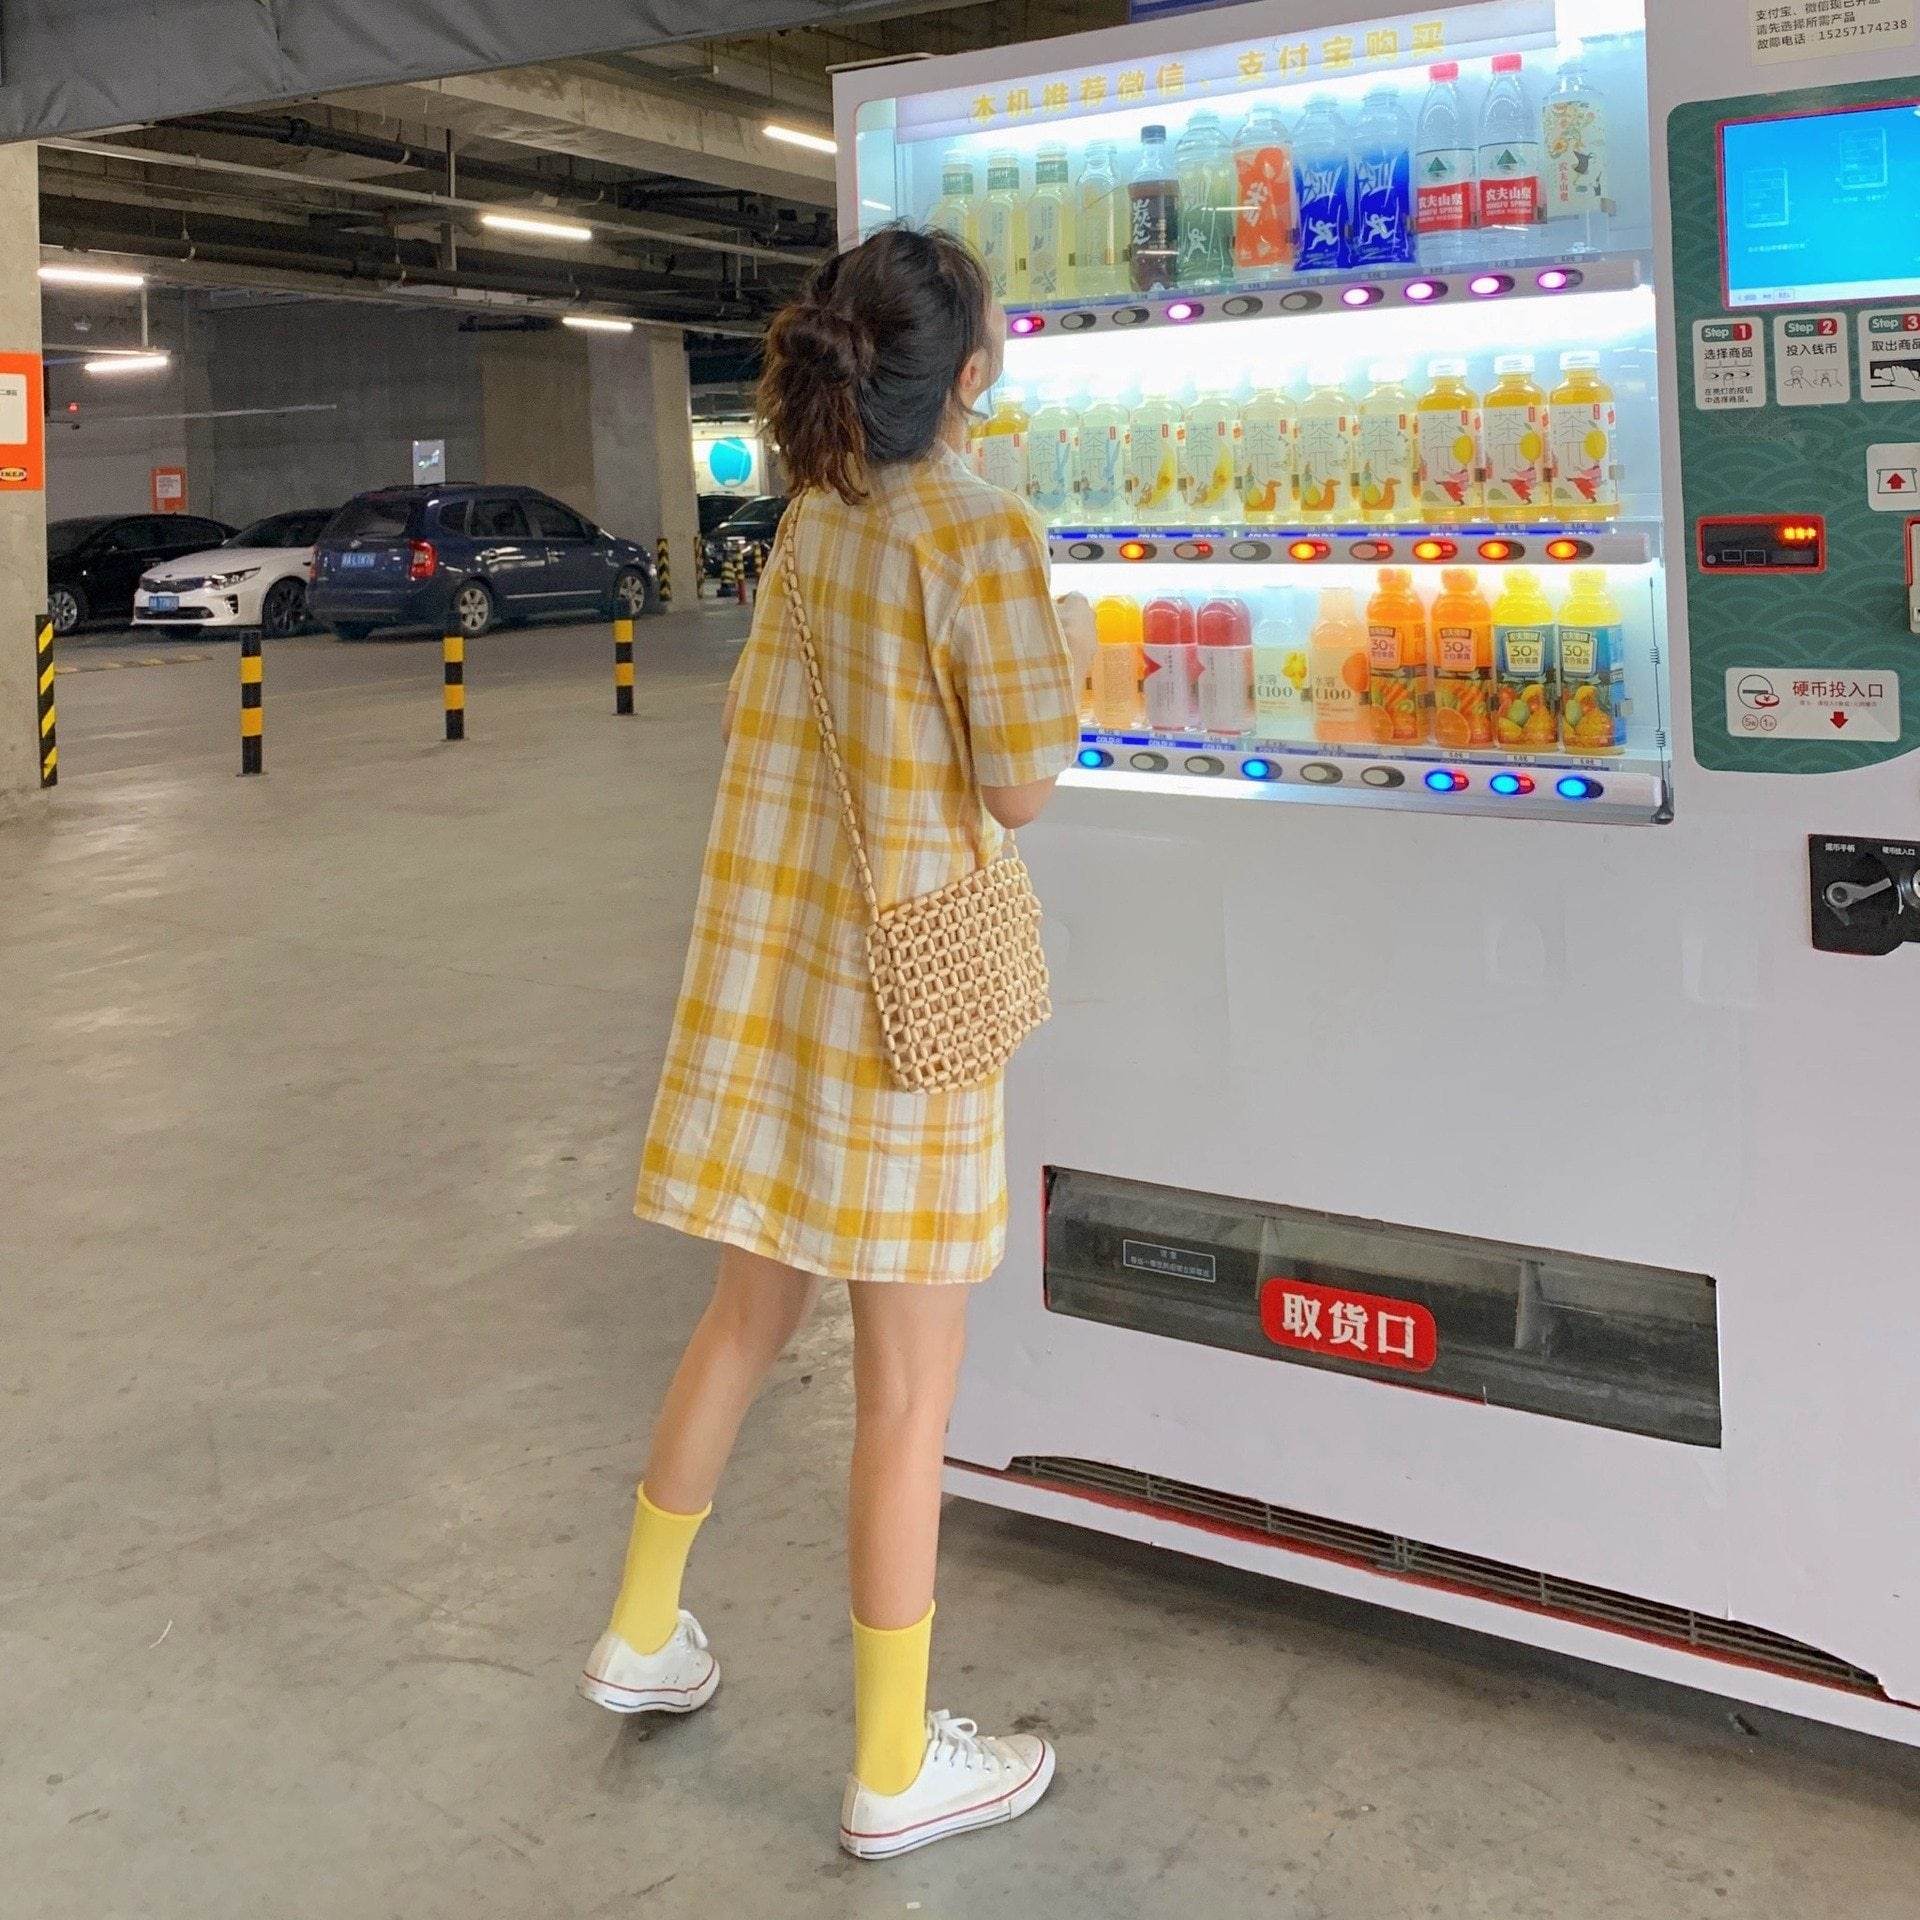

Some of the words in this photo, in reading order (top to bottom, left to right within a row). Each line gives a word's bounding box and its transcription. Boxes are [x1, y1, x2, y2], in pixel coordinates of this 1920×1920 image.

[1788, 322, 1815, 333] Step
[1823, 320, 1833, 334] 2
[1872, 319, 1899, 329] Step
[1908, 315, 1918, 329] 3
[1705, 328, 1729, 338] Step
[1739, 325, 1747, 338] 1
[1786, 343, 1838, 356] 投入钱币
[1872, 339, 1920, 351] 取出商品
[1704, 346, 1753, 359] 选择商品
[1511, 645, 1539, 656] 30%
[1564, 645, 1590, 656] 30%
[1792, 680, 1884, 698] 硬币投入口
[1282, 1292, 1416, 1359] 取货口
